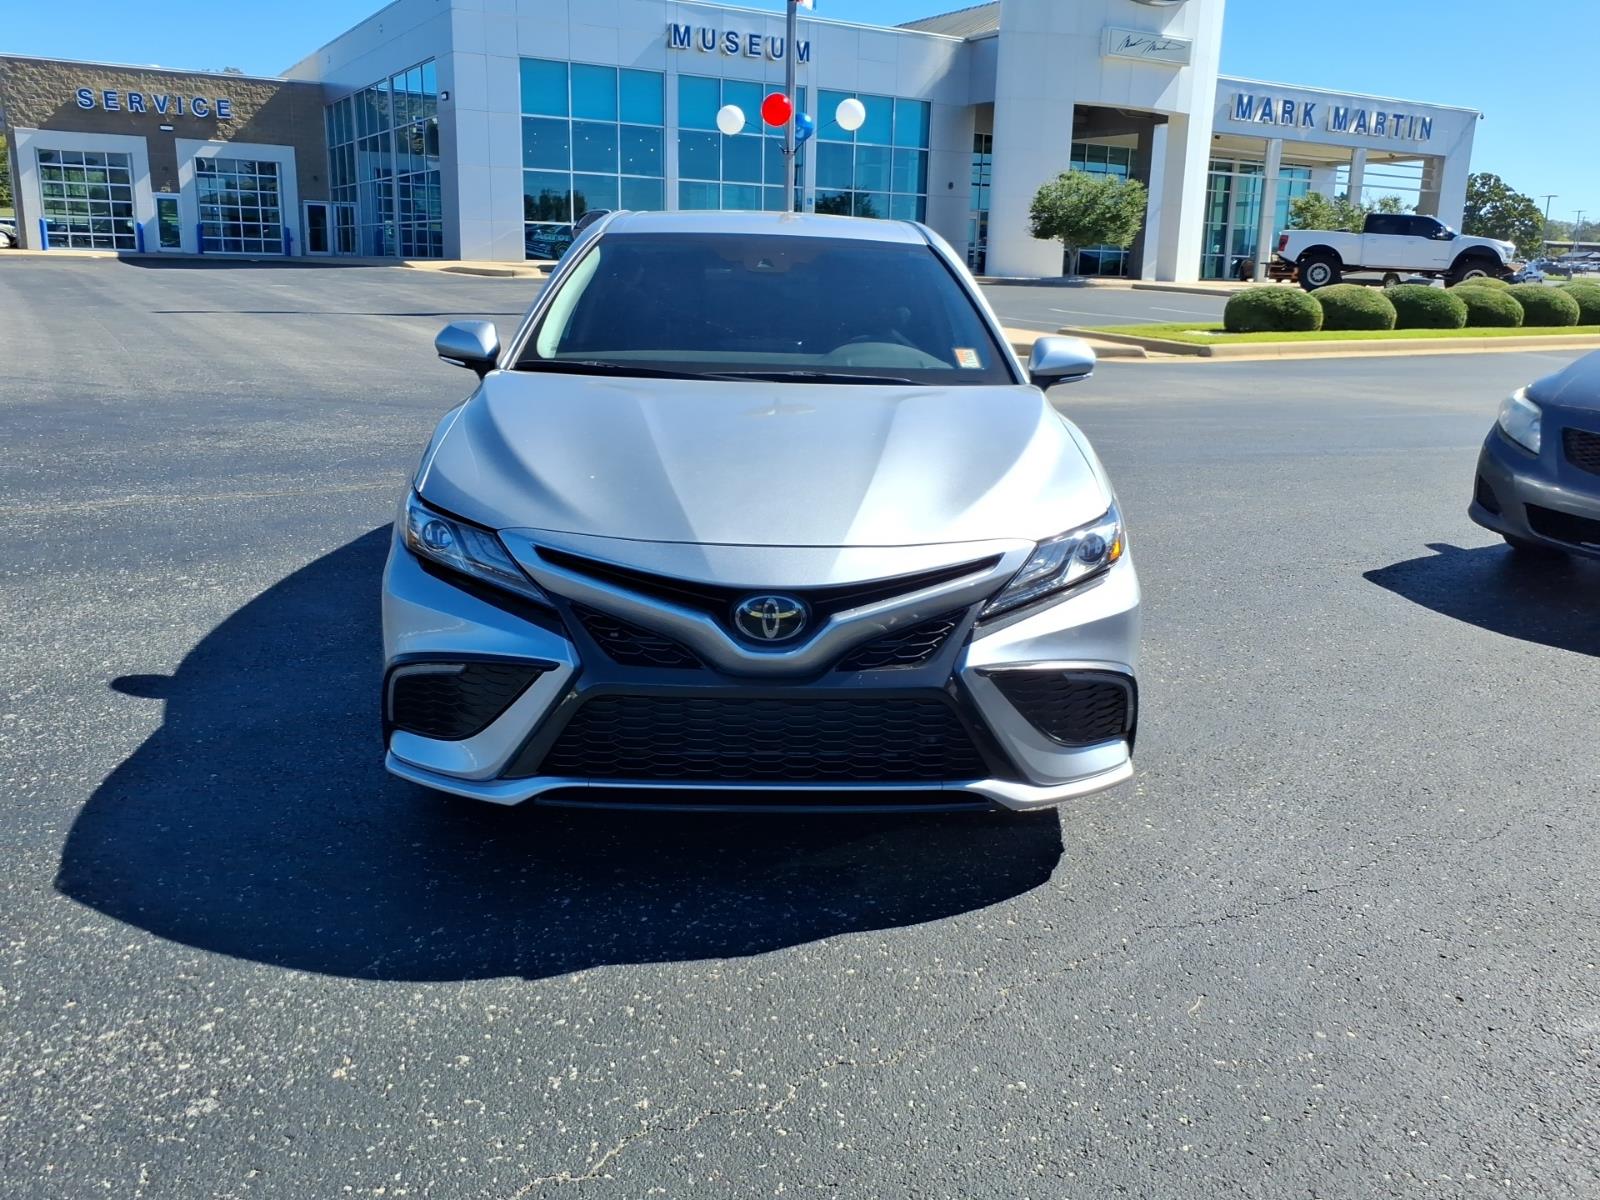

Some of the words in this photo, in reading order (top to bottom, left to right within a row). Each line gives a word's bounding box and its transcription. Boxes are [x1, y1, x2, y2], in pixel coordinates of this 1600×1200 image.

[669, 23, 811, 63] MUSEUM
[75, 87, 232, 119] SERVICE
[1231, 93, 1317, 128] MARK
[1328, 106, 1433, 141] MARTIN
